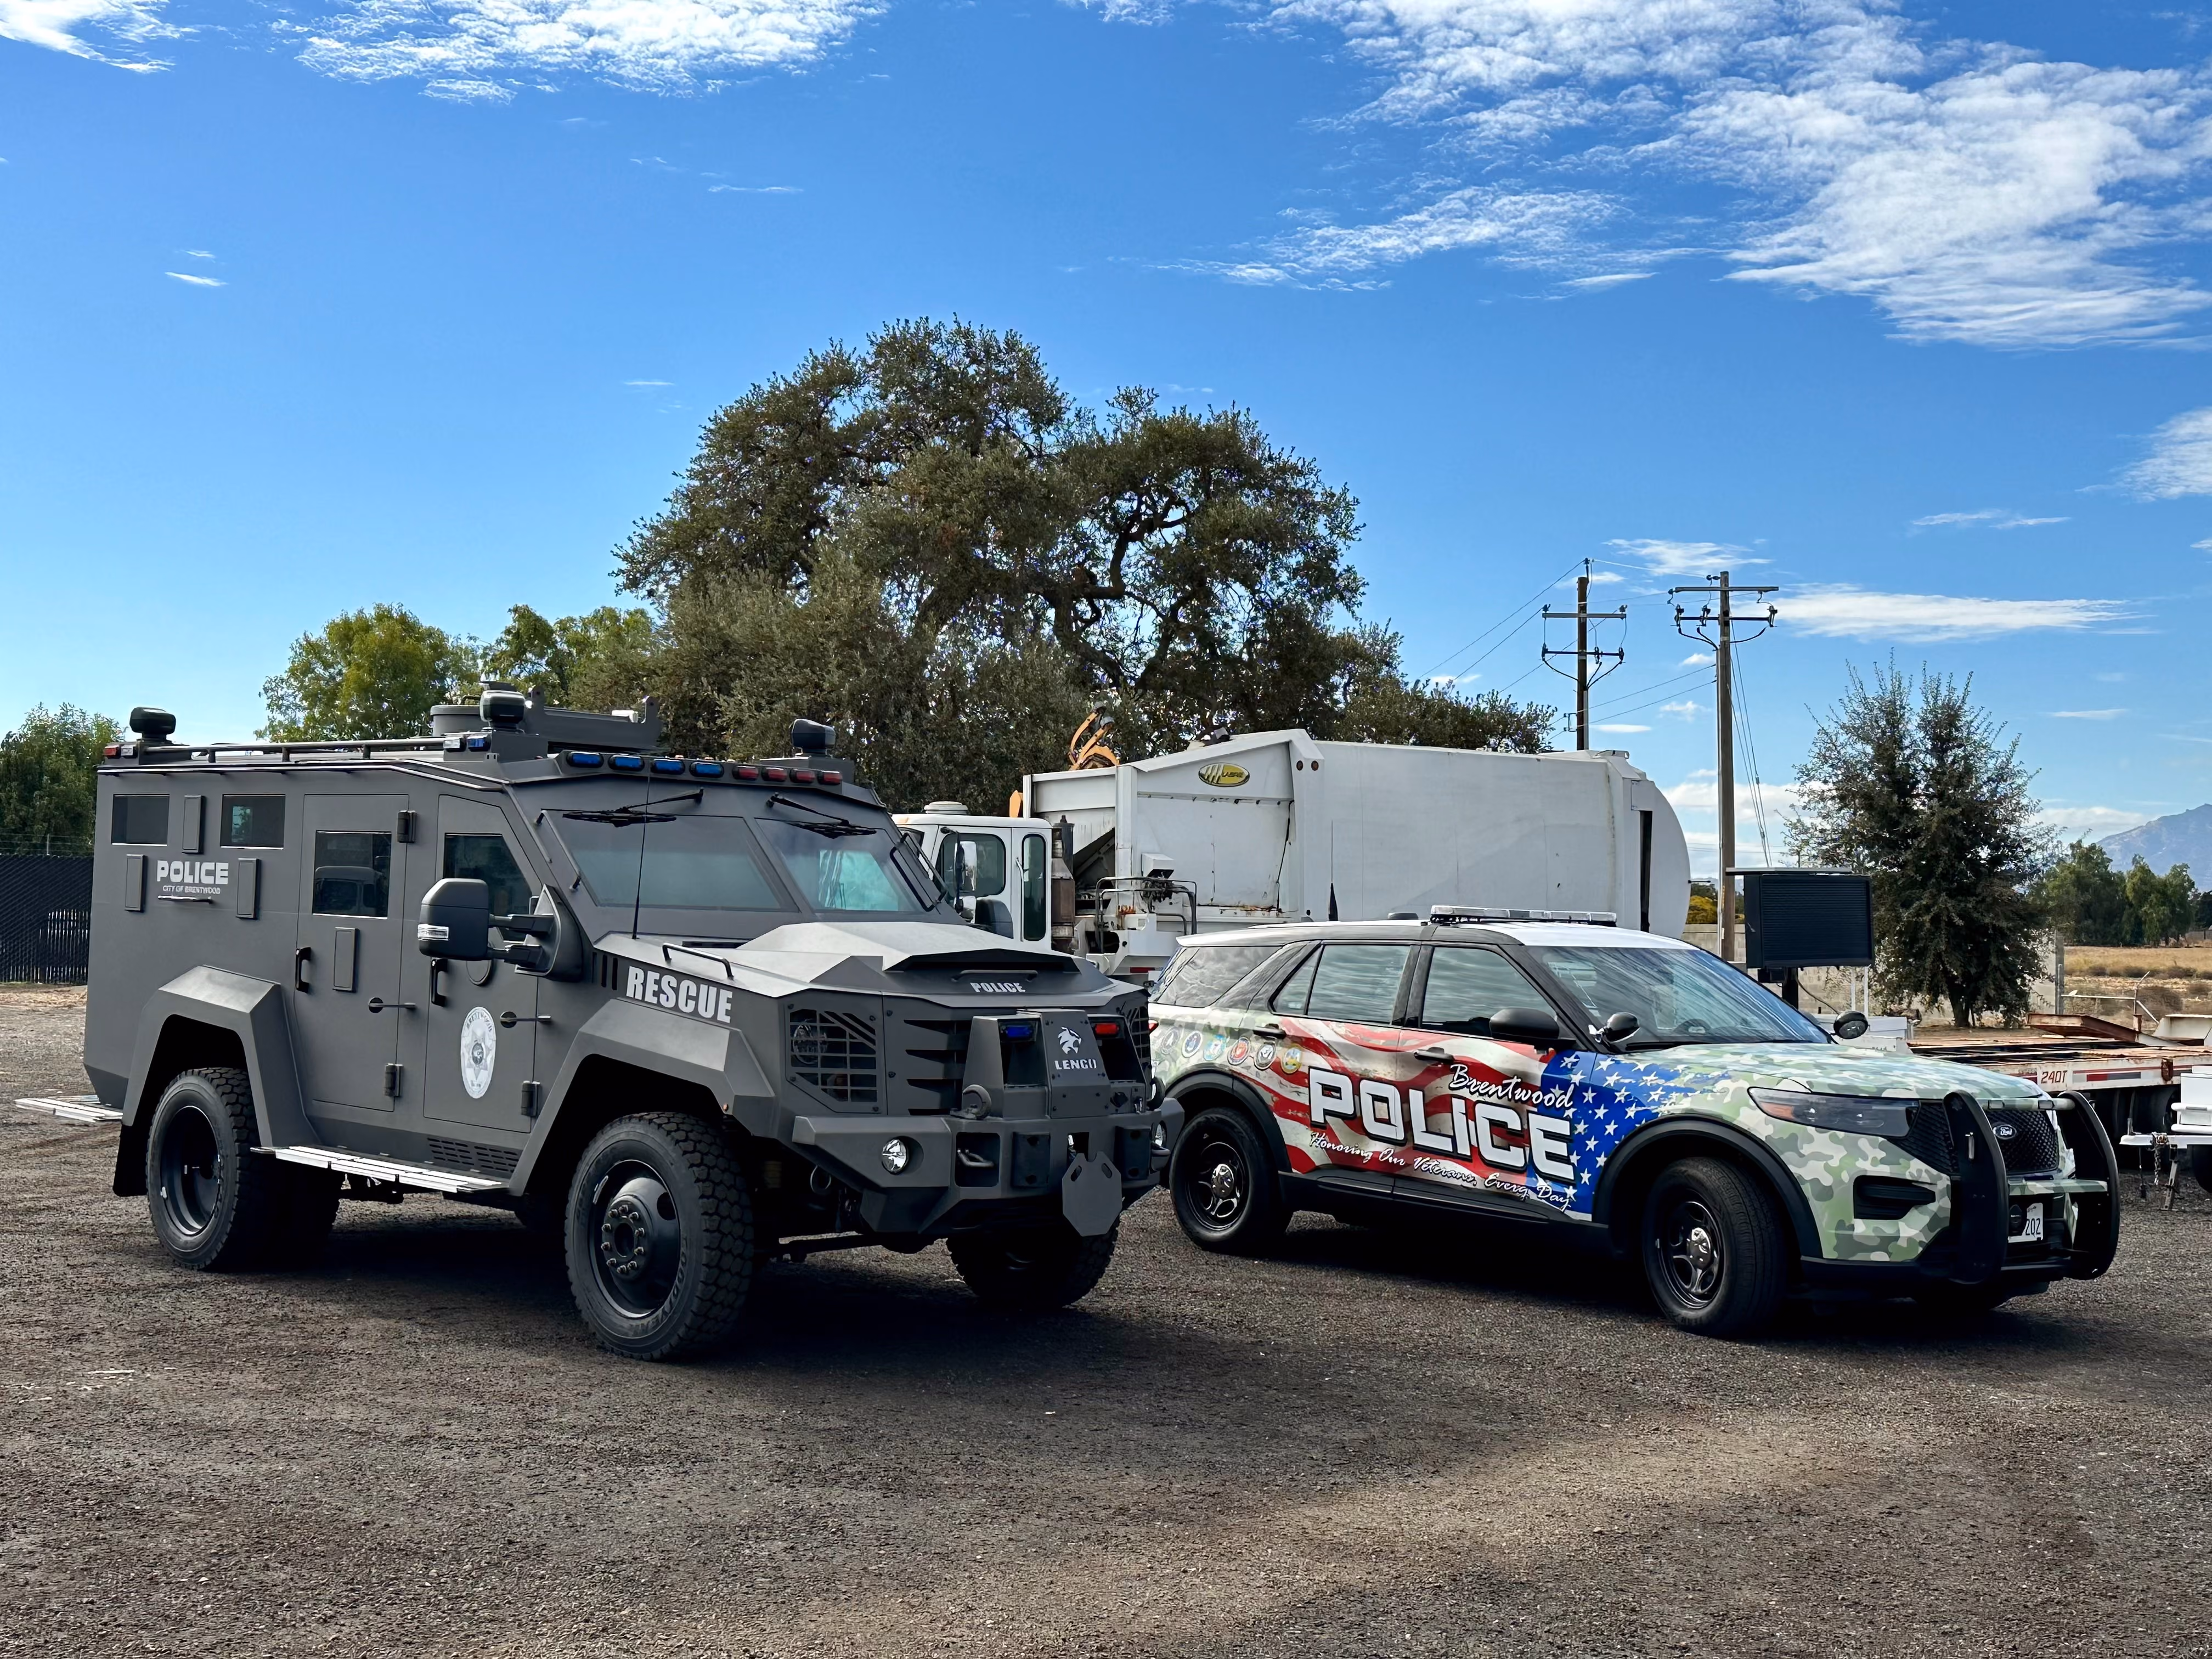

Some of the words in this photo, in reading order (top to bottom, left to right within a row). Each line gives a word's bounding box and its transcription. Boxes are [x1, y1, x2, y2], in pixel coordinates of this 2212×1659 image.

[157, 860, 229, 885] POLICE
[625, 966, 733, 1024] RESCUE
[969, 982, 1026, 993] POLICE
[1054, 1059, 1097, 1070] LENCO
[2040, 1070, 2068, 1084] 240T
[1448, 1064, 1574, 1109] Brentwood
[1308, 1066, 1576, 1182] POLICE
[1309, 1132, 1374, 1164] Honoring
[1379, 1148, 1406, 1166] Our
[1483, 1172, 1531, 1201] Every
[1536, 1184, 1572, 1213] Day
